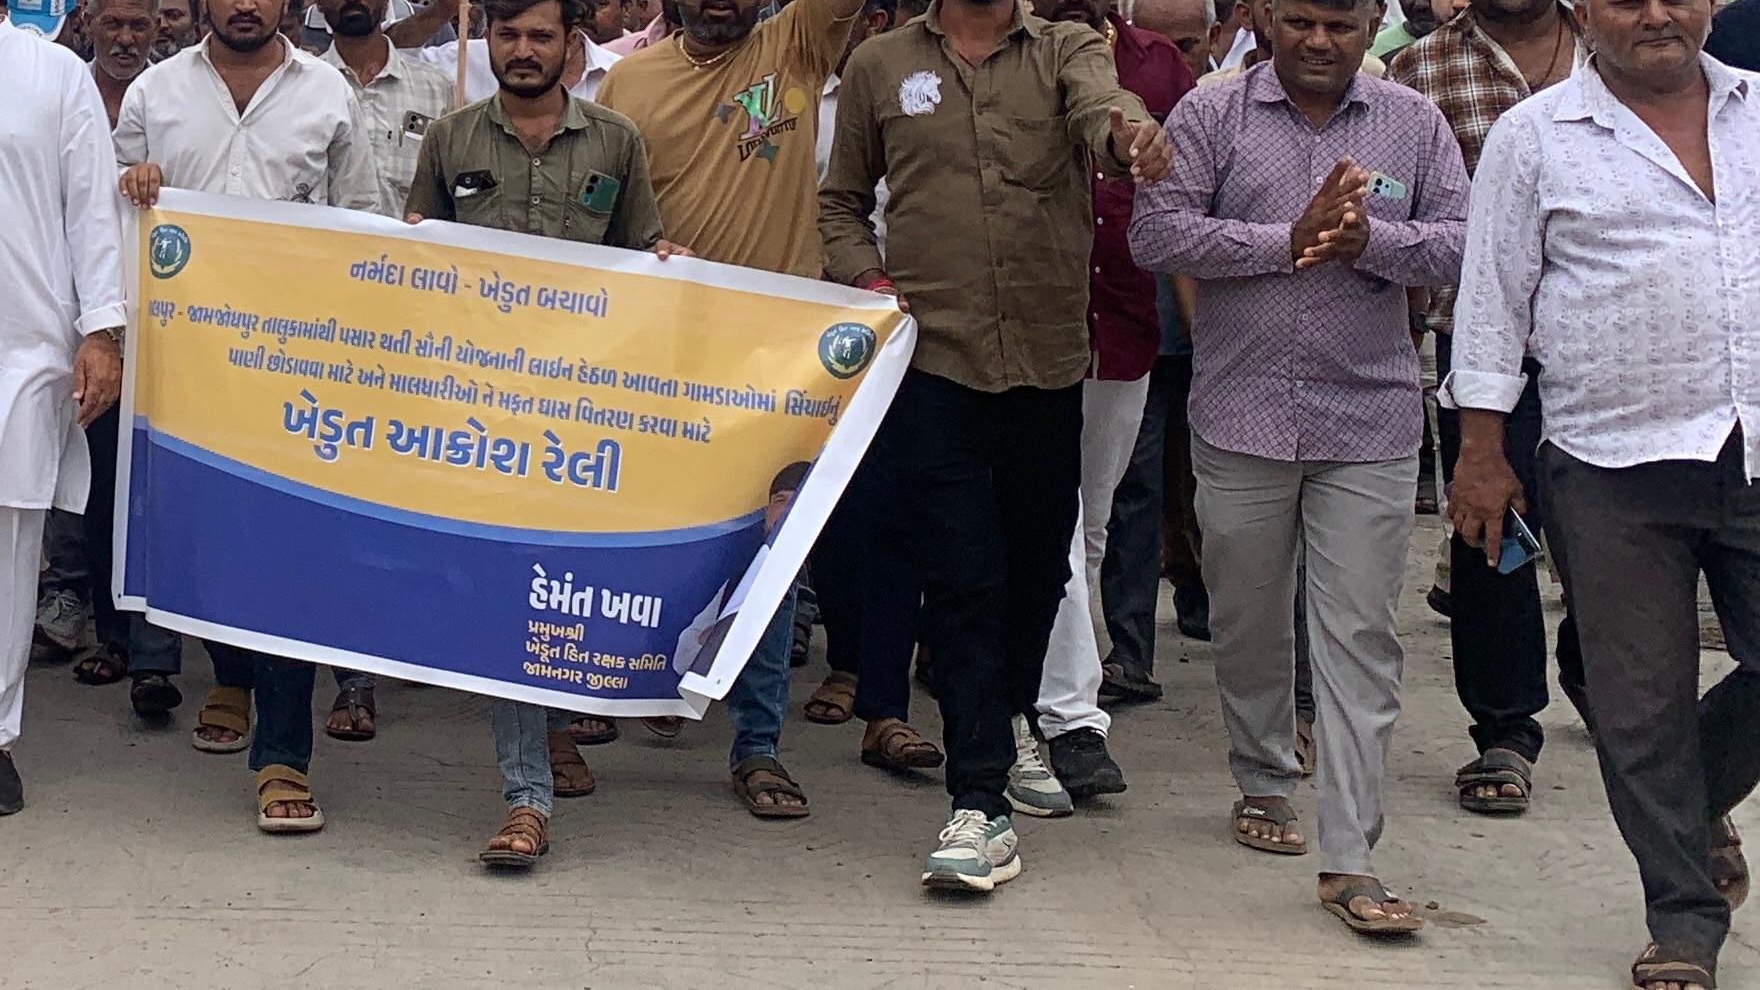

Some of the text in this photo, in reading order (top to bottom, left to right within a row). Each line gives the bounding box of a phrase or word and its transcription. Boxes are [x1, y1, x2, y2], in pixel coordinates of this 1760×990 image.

[350, 253, 608, 319] નર્મદા લાવો ખેડુત બચાવો
[187, 302, 259, 339] જામજોધપુર
[261, 317, 337, 345] તાલુકામાંથી
[340, 327, 376, 351] પસાર
[379, 329, 412, 355] થતી
[415, 334, 452, 363] સૌની
[456, 339, 525, 375] યોજનાની
[527, 354, 574, 382] લાઈન
[577, 357, 617, 388] હેઠળ
[622, 371, 678, 398] આવતા
[683, 381, 776, 413] ગામડાઓમાં
[228, 346, 711, 444] પાણી છોડાવવા માટે અને માલધારીઓ ને મફત ઘાસ વિતરણ કરવા માટે
[283, 389, 622, 493] ખેડુત આક્રોશ રેલી
[528, 562, 662, 628] હેમંત ખવા
[527, 619, 585, 642] પ્રમુખશ્રી
[523, 660, 629, 691] જામનગર જીલ્લા
